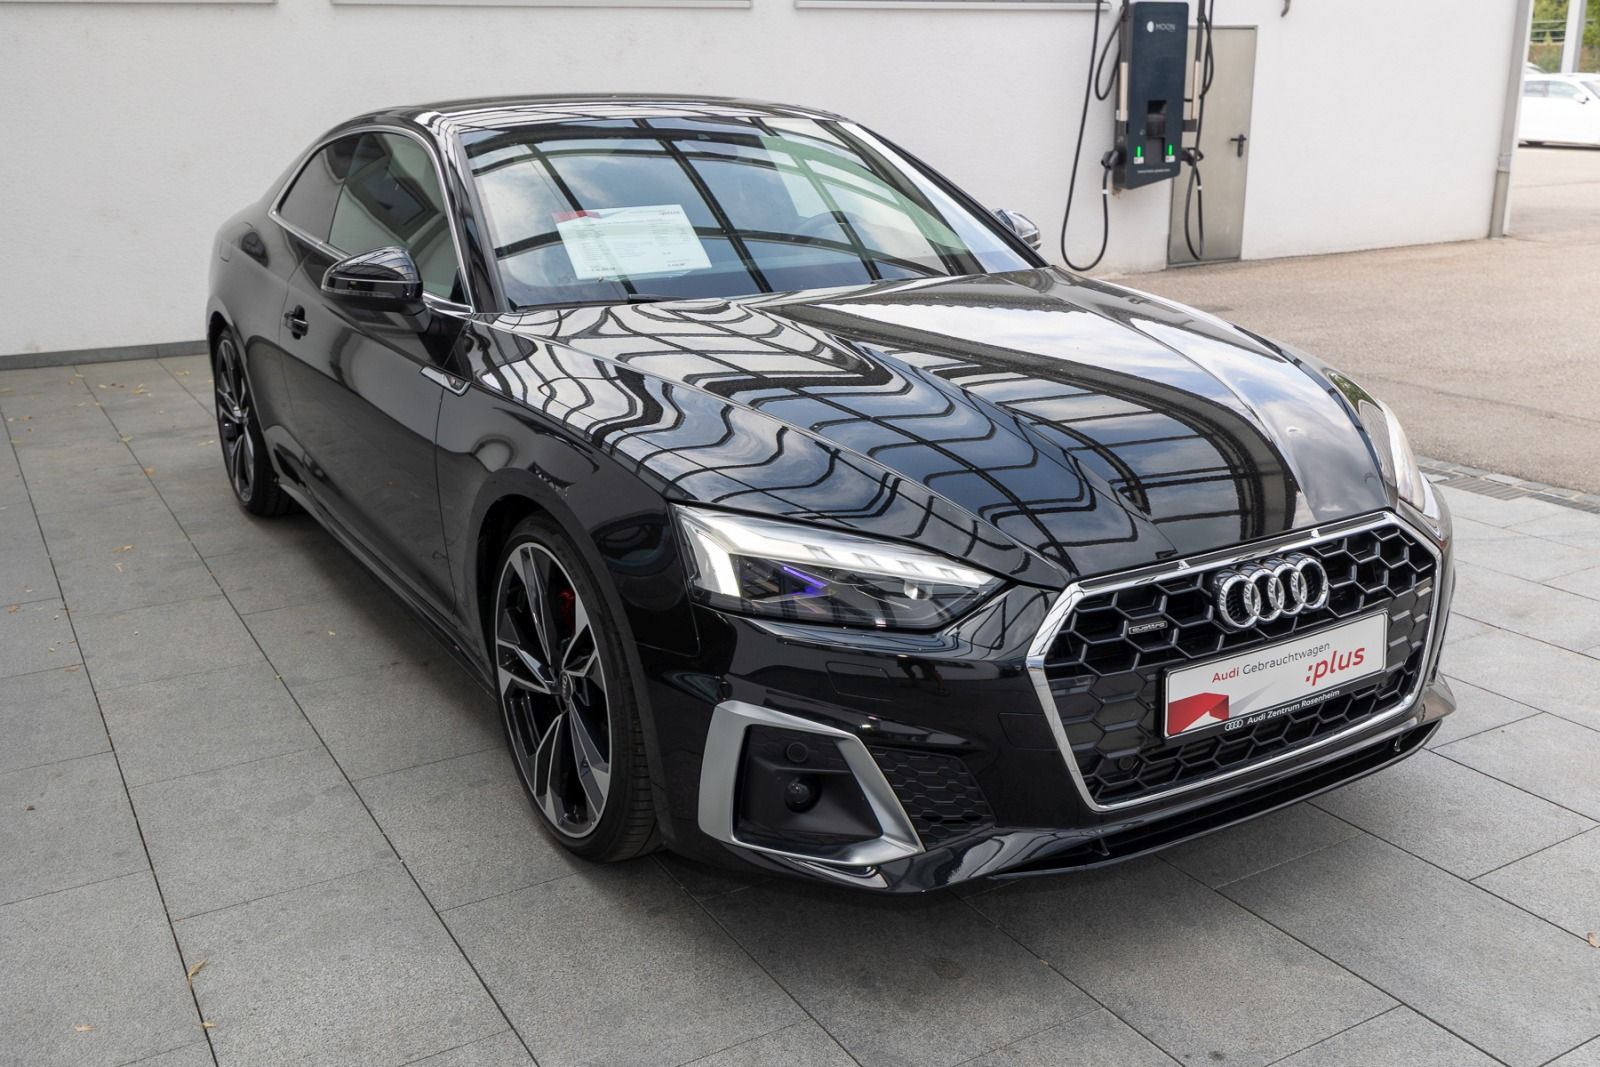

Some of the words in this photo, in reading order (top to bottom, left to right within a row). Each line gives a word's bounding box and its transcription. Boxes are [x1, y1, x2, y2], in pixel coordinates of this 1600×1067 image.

[1155, 23, 1176, 31] MOON
[1212, 669, 1240, 683] Audi
[1242, 642, 1330, 675] Gebrauchtwagen
[1247, 712, 1266, 725] Audi
[1267, 704, 1300, 720] Zentrum
[1301, 689, 1340, 708] Rosenheim
